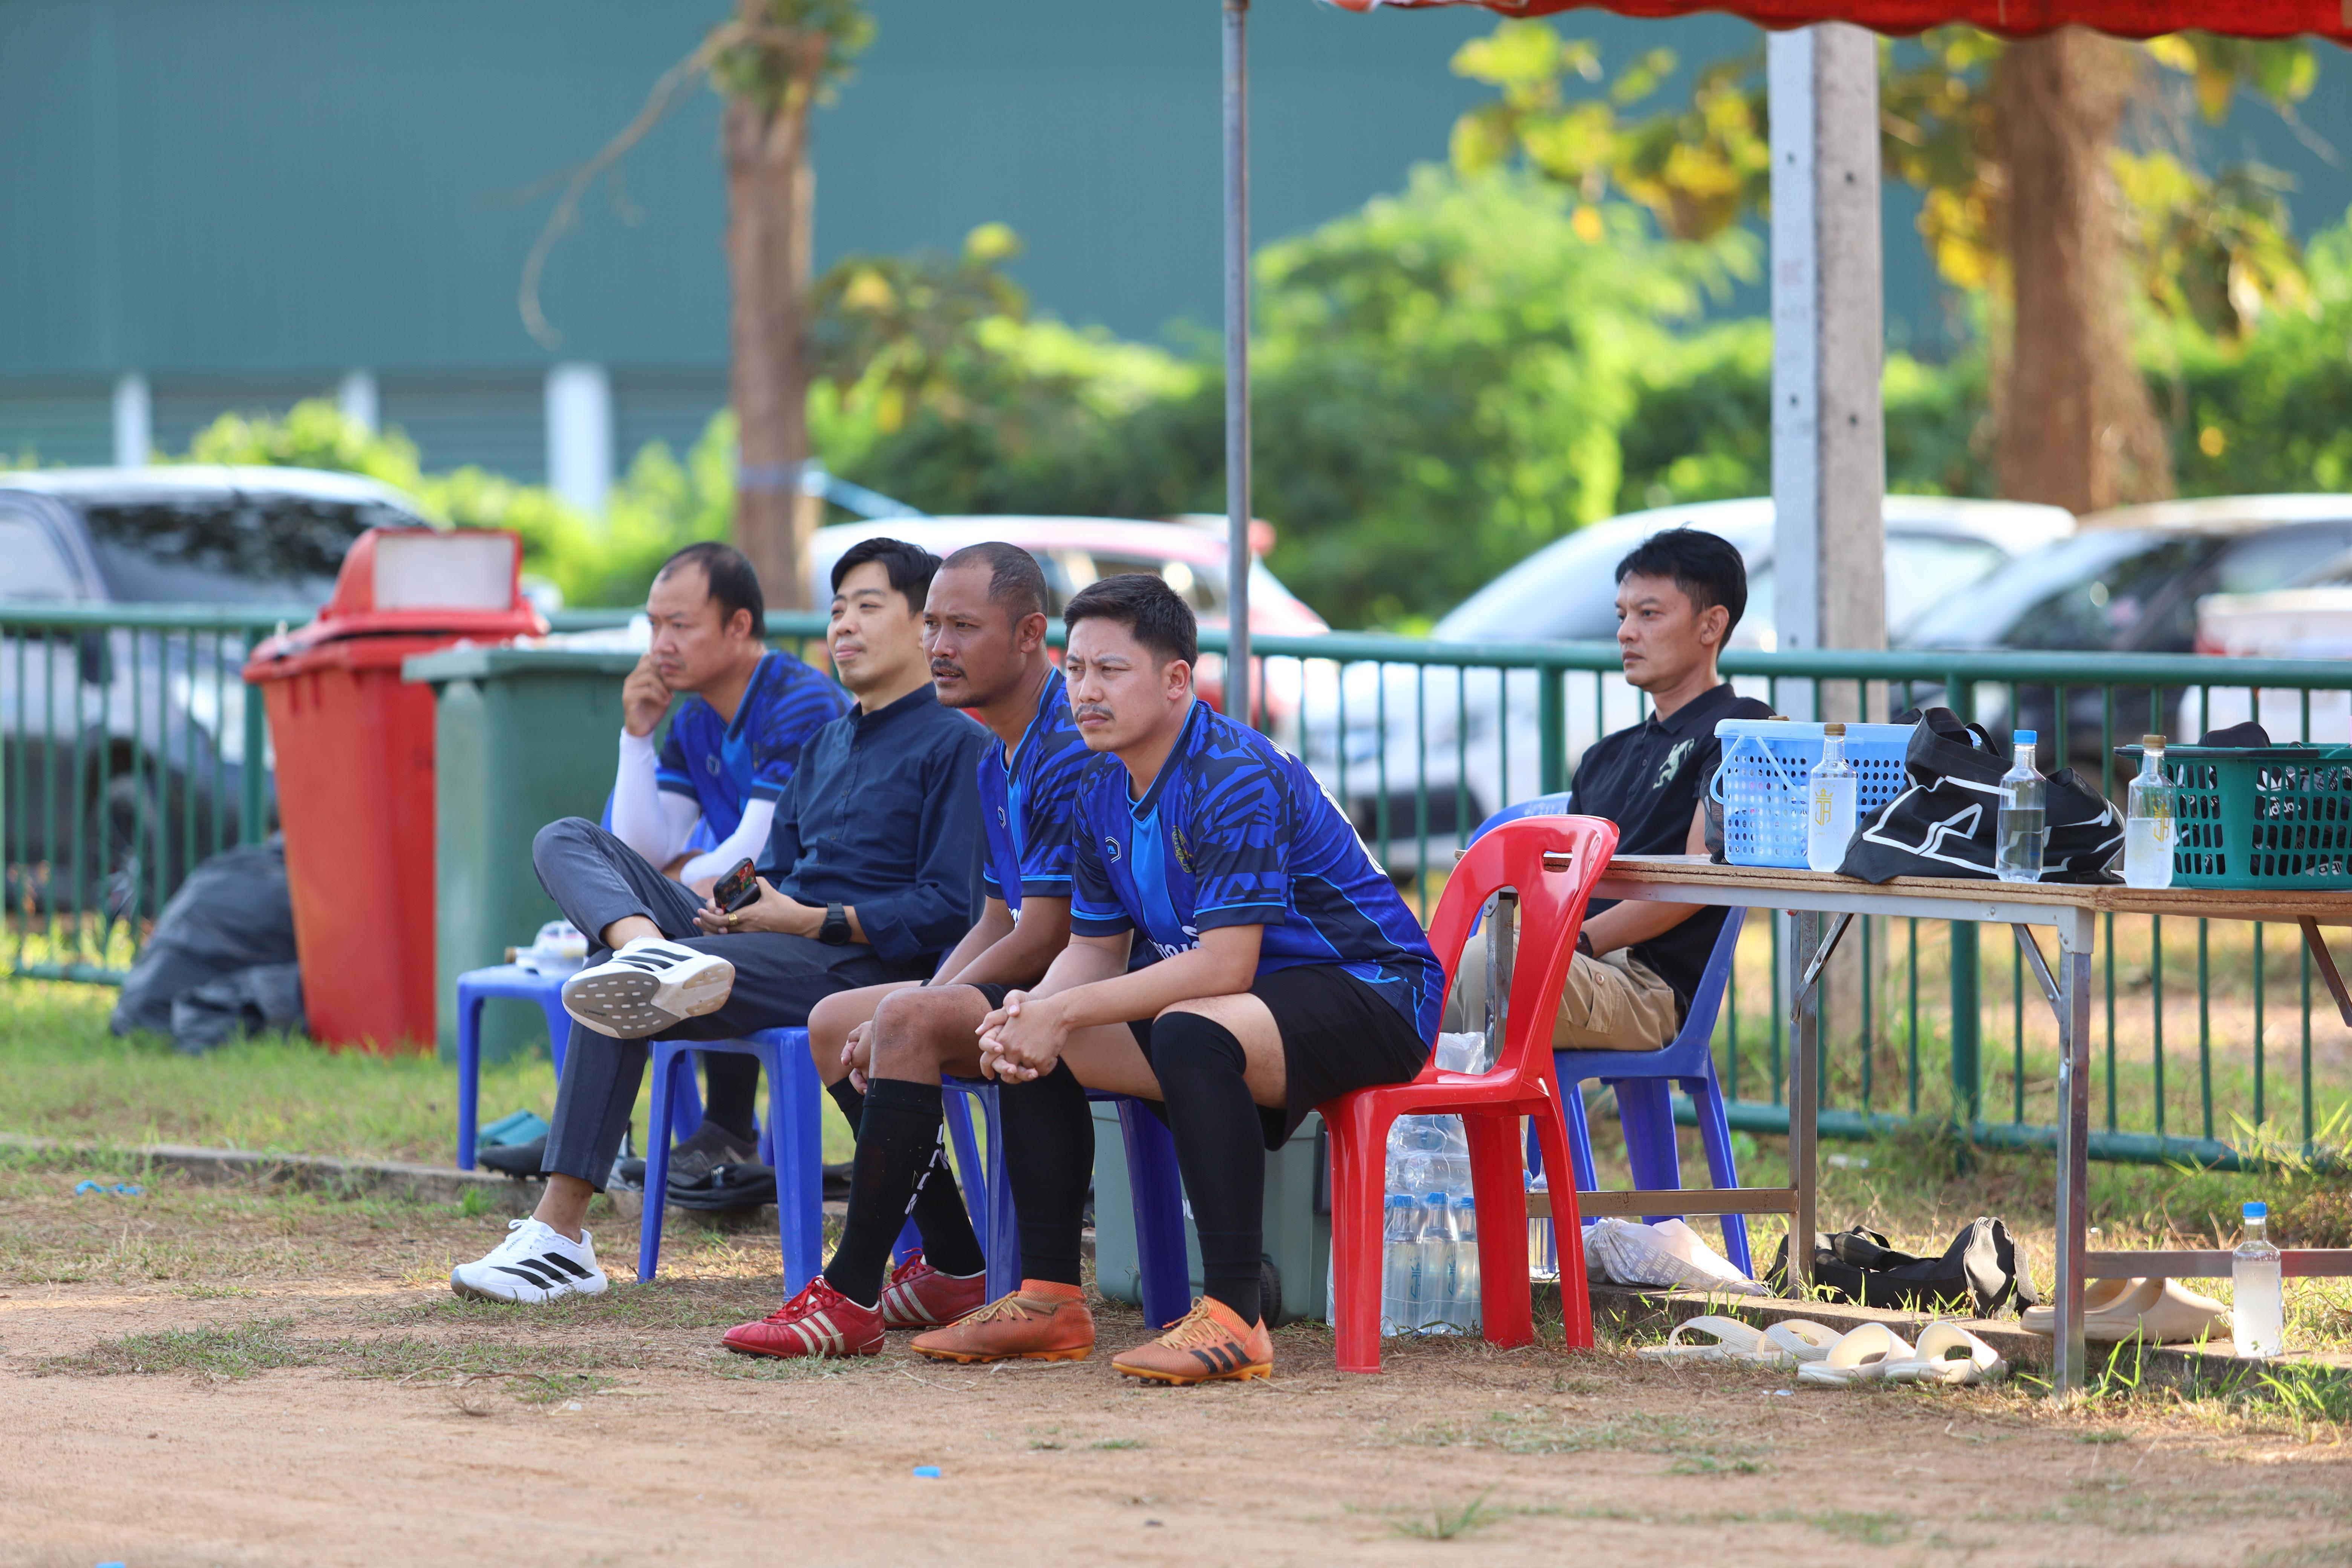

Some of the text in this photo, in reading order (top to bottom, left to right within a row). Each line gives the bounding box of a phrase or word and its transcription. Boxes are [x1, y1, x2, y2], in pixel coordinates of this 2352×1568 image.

[1815, 800, 1832, 827] JR
[1652, 1251, 1669, 1273] NIKE
[1663, 1258, 1681, 1280] NIKE
